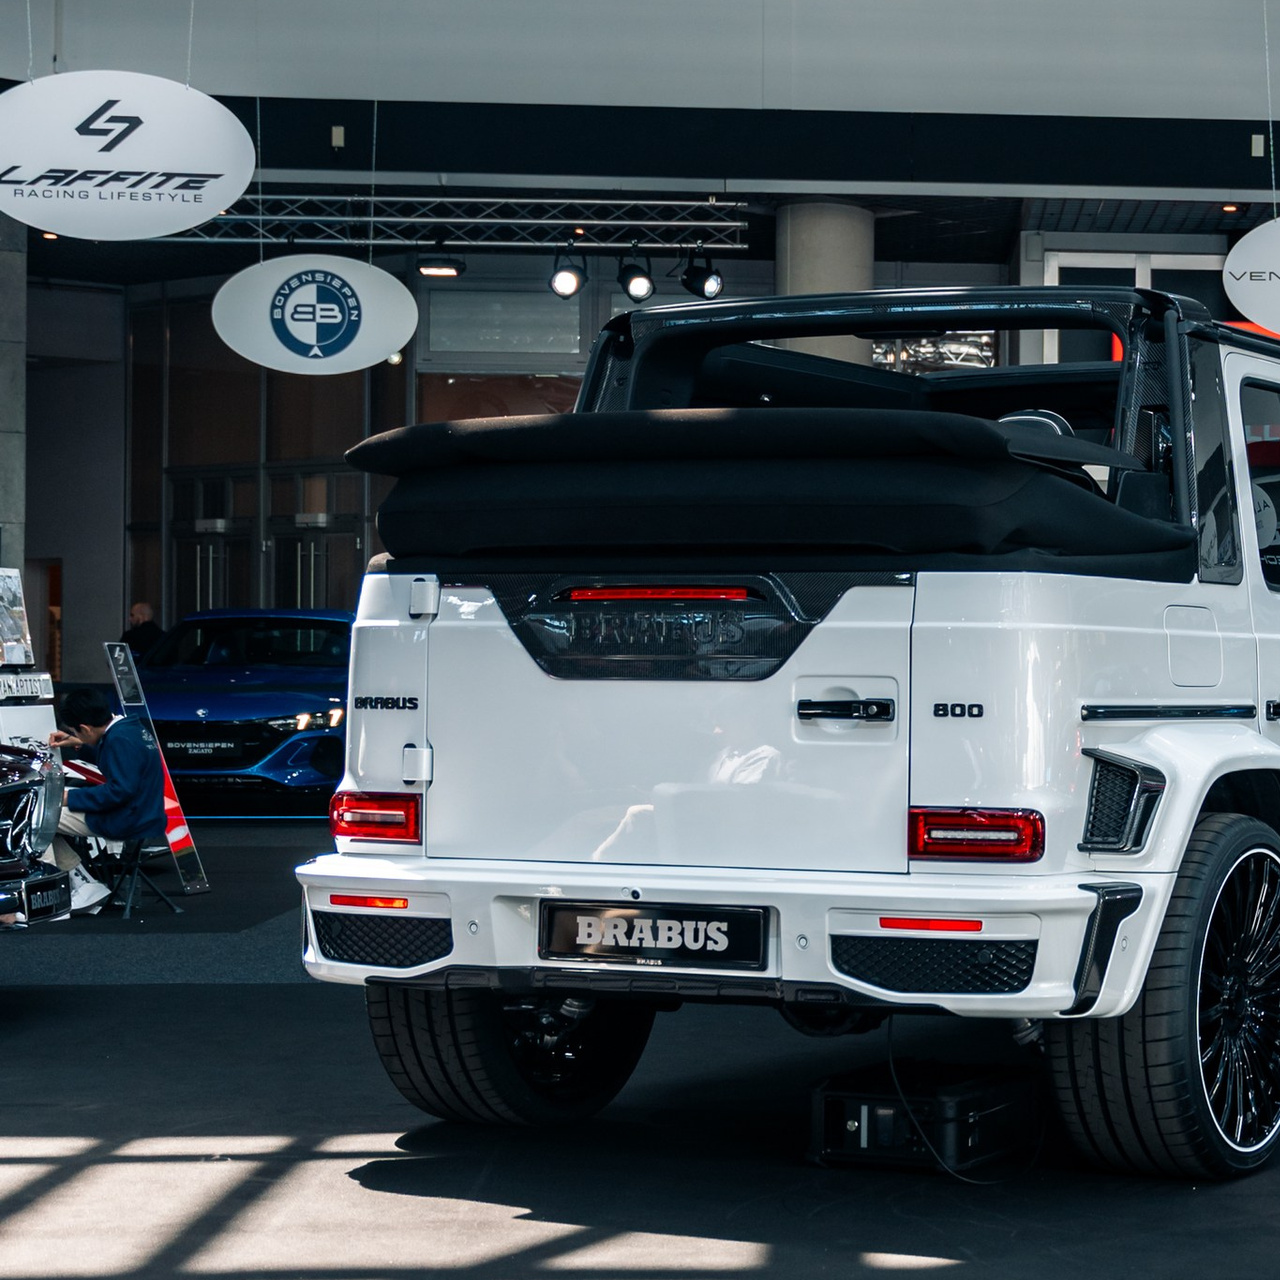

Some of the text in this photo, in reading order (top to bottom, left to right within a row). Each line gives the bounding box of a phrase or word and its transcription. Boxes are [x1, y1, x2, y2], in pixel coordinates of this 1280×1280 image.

[0, 165, 225, 191] LAFFITE
[14, 188, 203, 203] RACING LIFESTYLE
[272, 272, 359, 321] BOVENSIEPEN
[354, 696, 419, 710] BRABUS
[933, 703, 984, 718] 800
[576, 915, 730, 952] BRABUS
